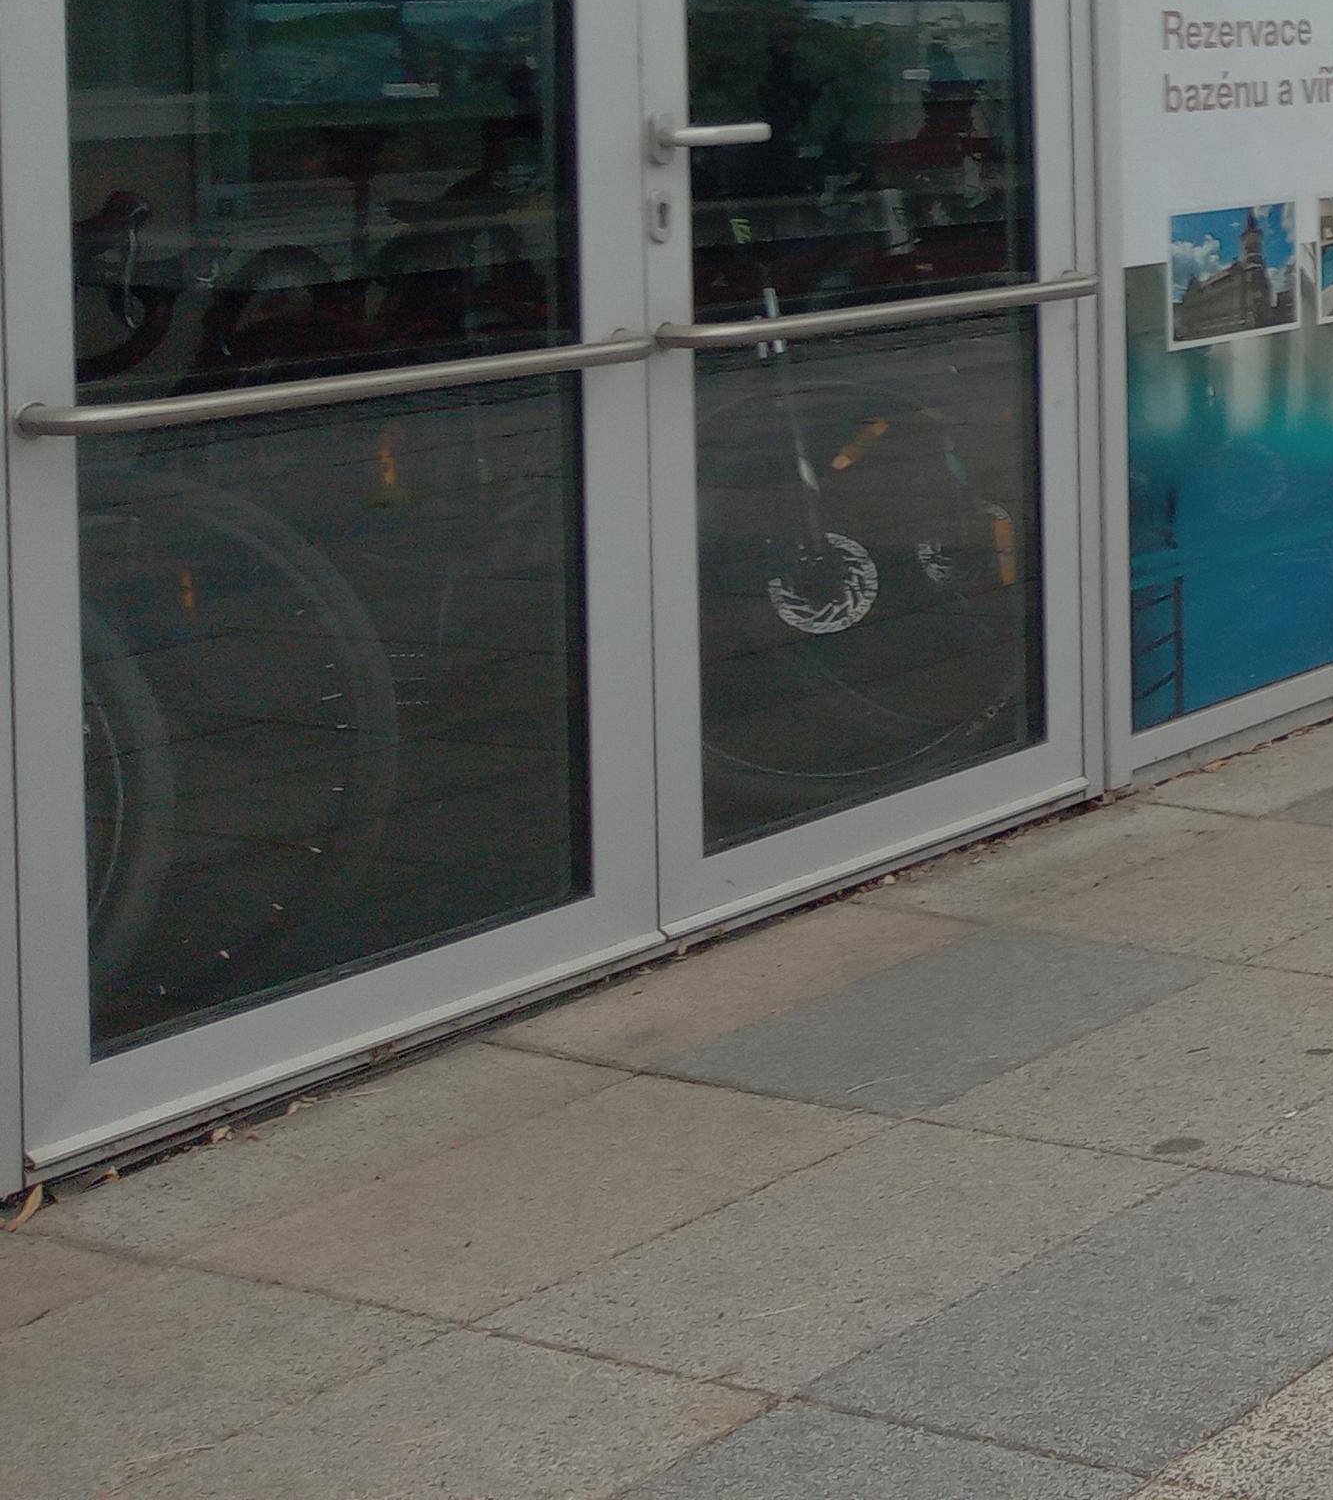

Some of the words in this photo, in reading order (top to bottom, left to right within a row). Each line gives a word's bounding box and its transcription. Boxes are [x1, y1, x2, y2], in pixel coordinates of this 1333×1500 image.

[1161, 10, 1312, 51] Rezervace
[1163, 73, 1269, 113] bazénu
[1278, 79, 1294, 106] a
